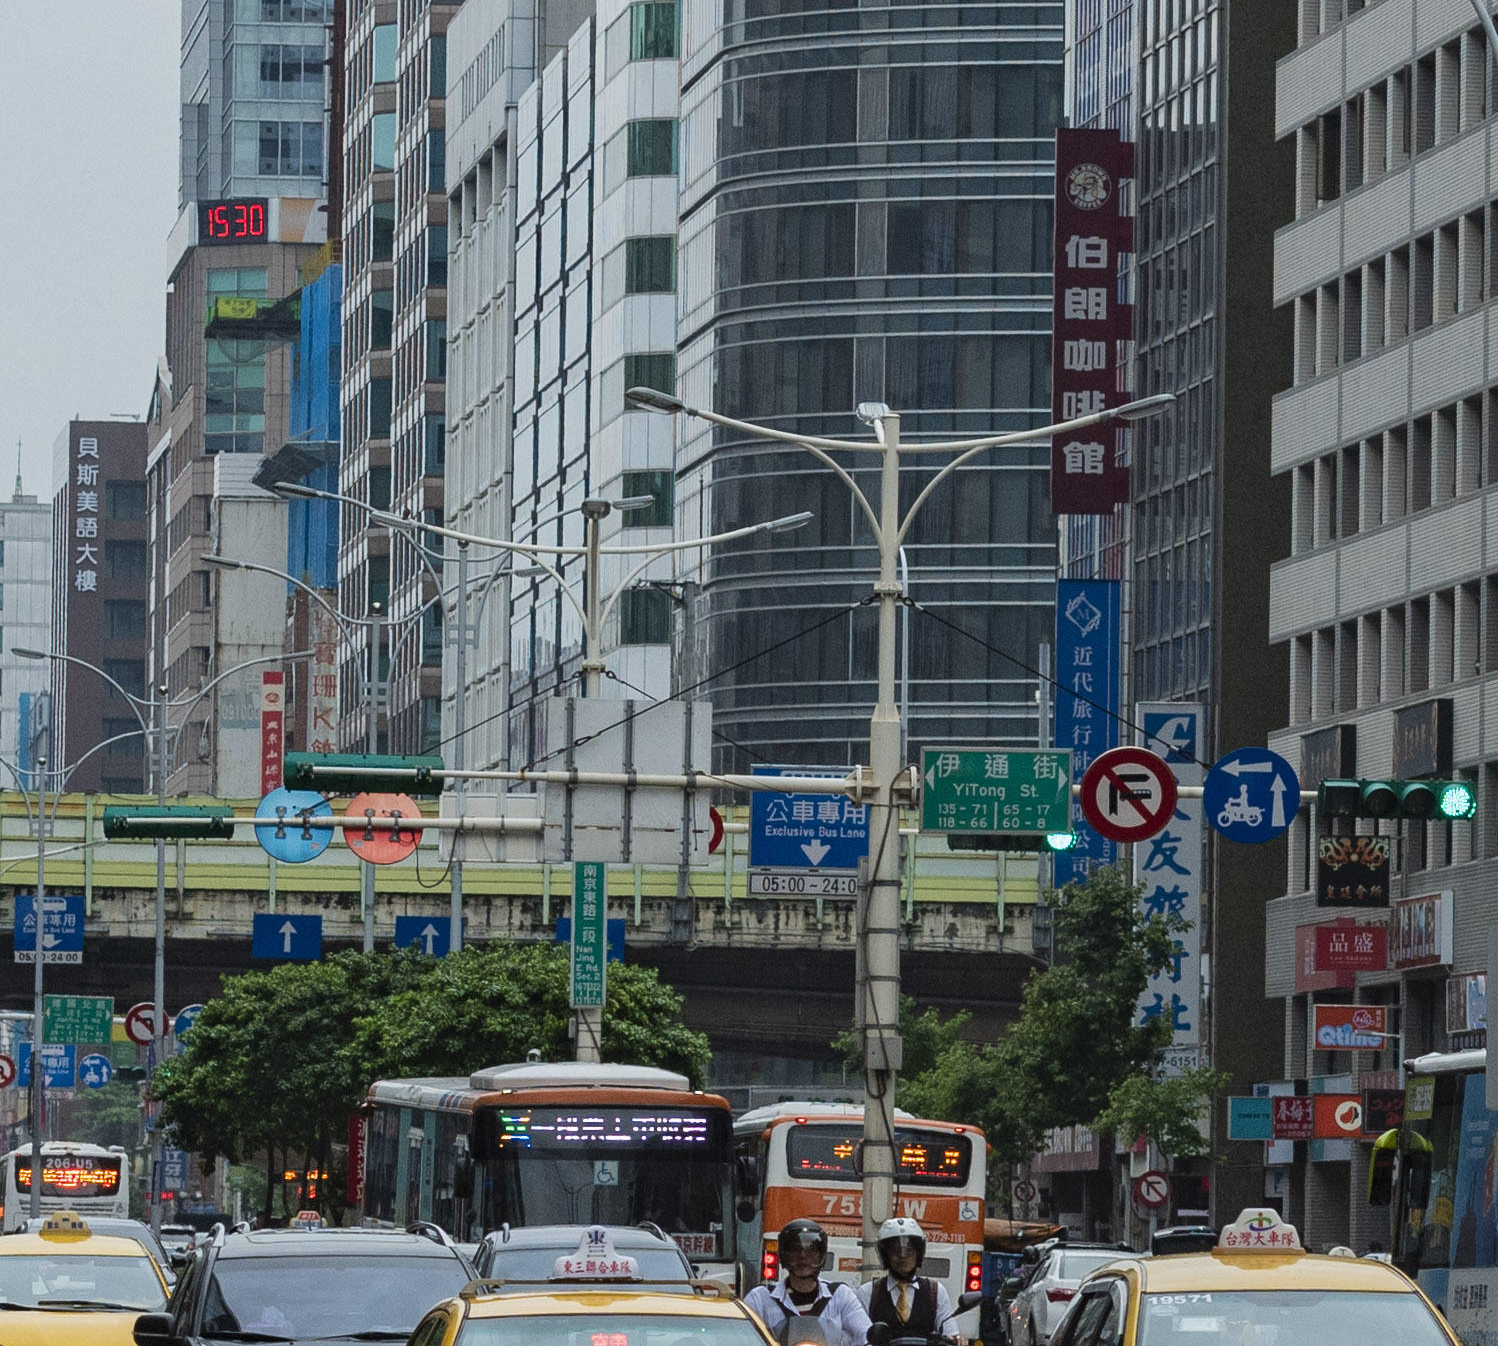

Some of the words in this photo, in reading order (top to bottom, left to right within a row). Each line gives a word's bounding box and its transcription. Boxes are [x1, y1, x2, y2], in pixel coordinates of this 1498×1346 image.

[75, 435, 100, 594] 貝斯美語大樓
[936, 753, 1058, 779] 伊通街
[953, 783, 1006, 800] YiTong
[1020, 784, 1040, 798] St.
[765, 799, 867, 825] 公車專用
[938, 803, 957, 815] 135
[972, 803, 988, 815] 71
[1003, 803, 1020, 815] 65
[1037, 804, 1051, 816] 17
[938, 816, 956, 829] 118
[970, 816, 988, 829] 66
[1002, 817, 1021, 829] 60
[1036, 816, 1047, 829] 8
[764, 824, 815, 838] Exclusive
[818, 825, 838, 838] Bus
[839, 826, 866, 839] Lane
[761, 875, 805, 893] 05:00
[582, 864, 598, 944] 南京東路二段
[576, 945, 593, 953] Nan
[1329, 931, 1375, 955] 品盛
[576, 953, 595, 963] Jing
[1225, 1231, 1295, 1247] 台灣大車隊
[563, 1259, 633, 1275] 東三聯合車隊
[1147, 1292, 1213, 1307] 19571
